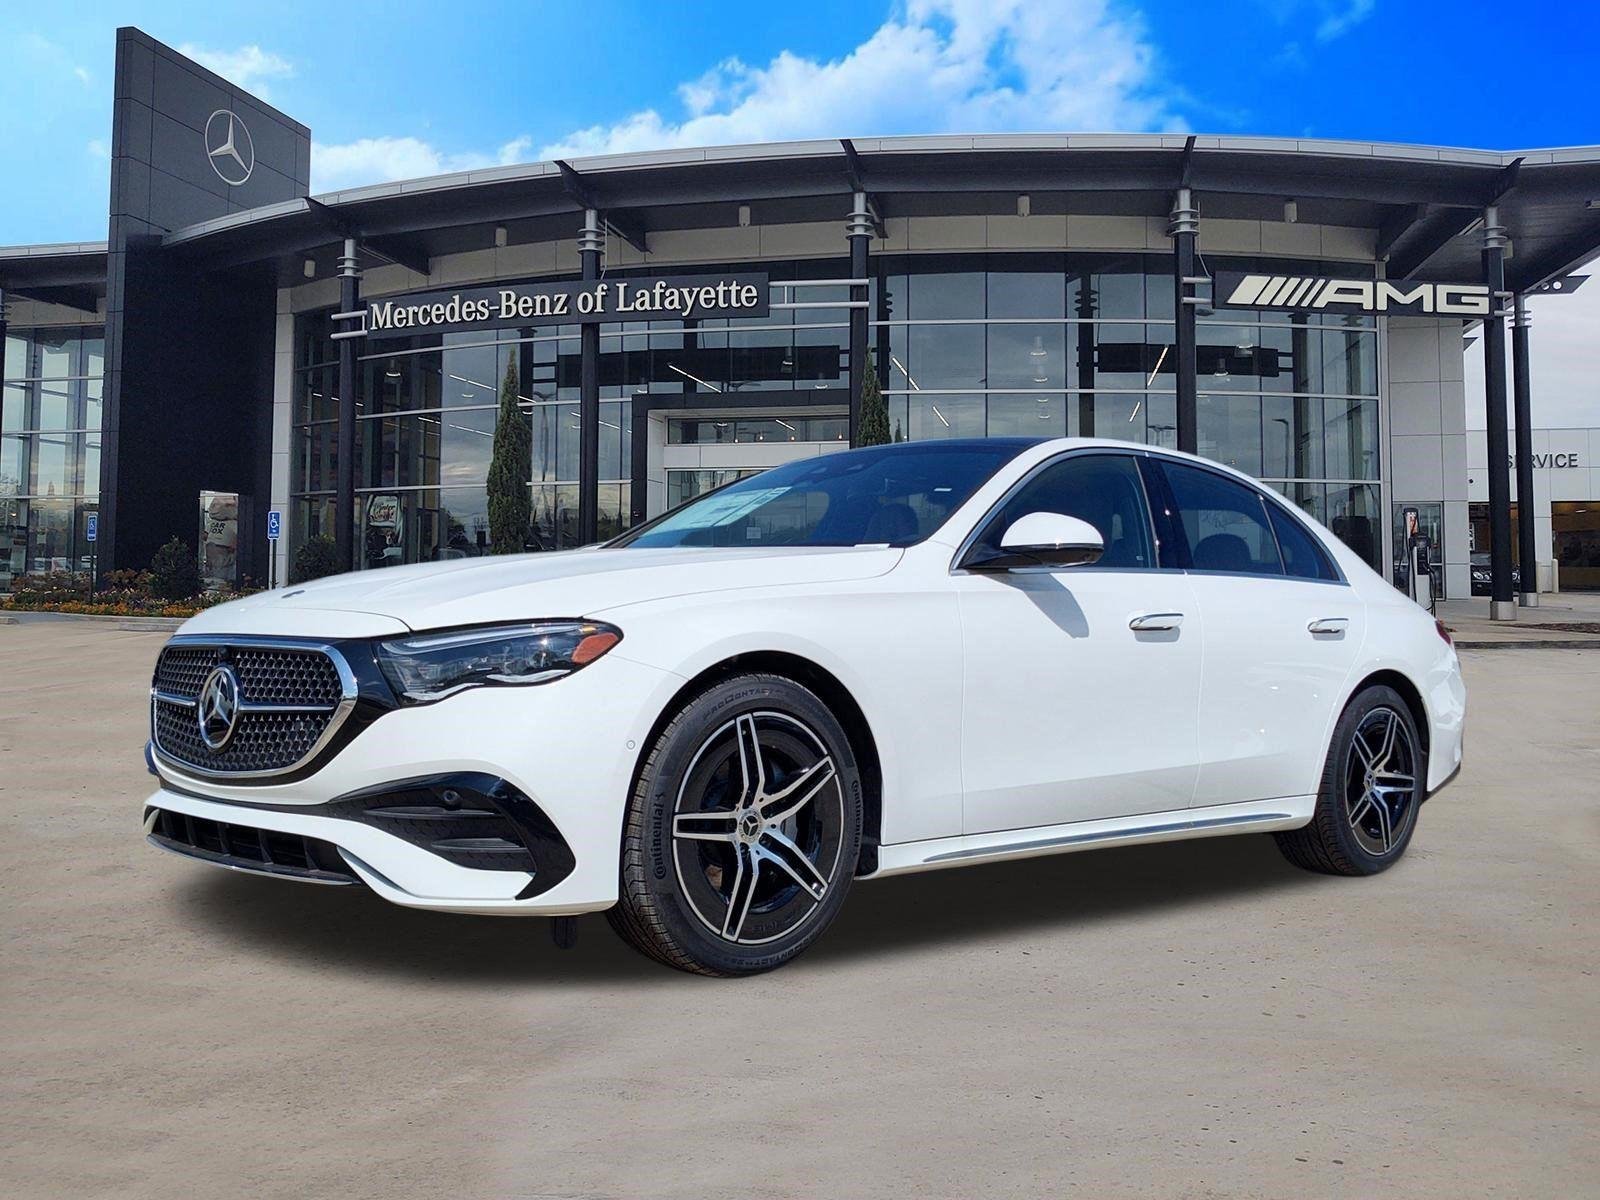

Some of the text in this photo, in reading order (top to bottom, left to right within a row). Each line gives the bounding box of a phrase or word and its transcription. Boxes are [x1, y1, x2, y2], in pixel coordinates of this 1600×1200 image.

[370, 279, 758, 330] Mercedes-Benz of Lafayette
[1312, 280, 1490, 315] AMG
[1508, 453, 1578, 468] SRVICE
[651, 802, 667, 880] Continental
